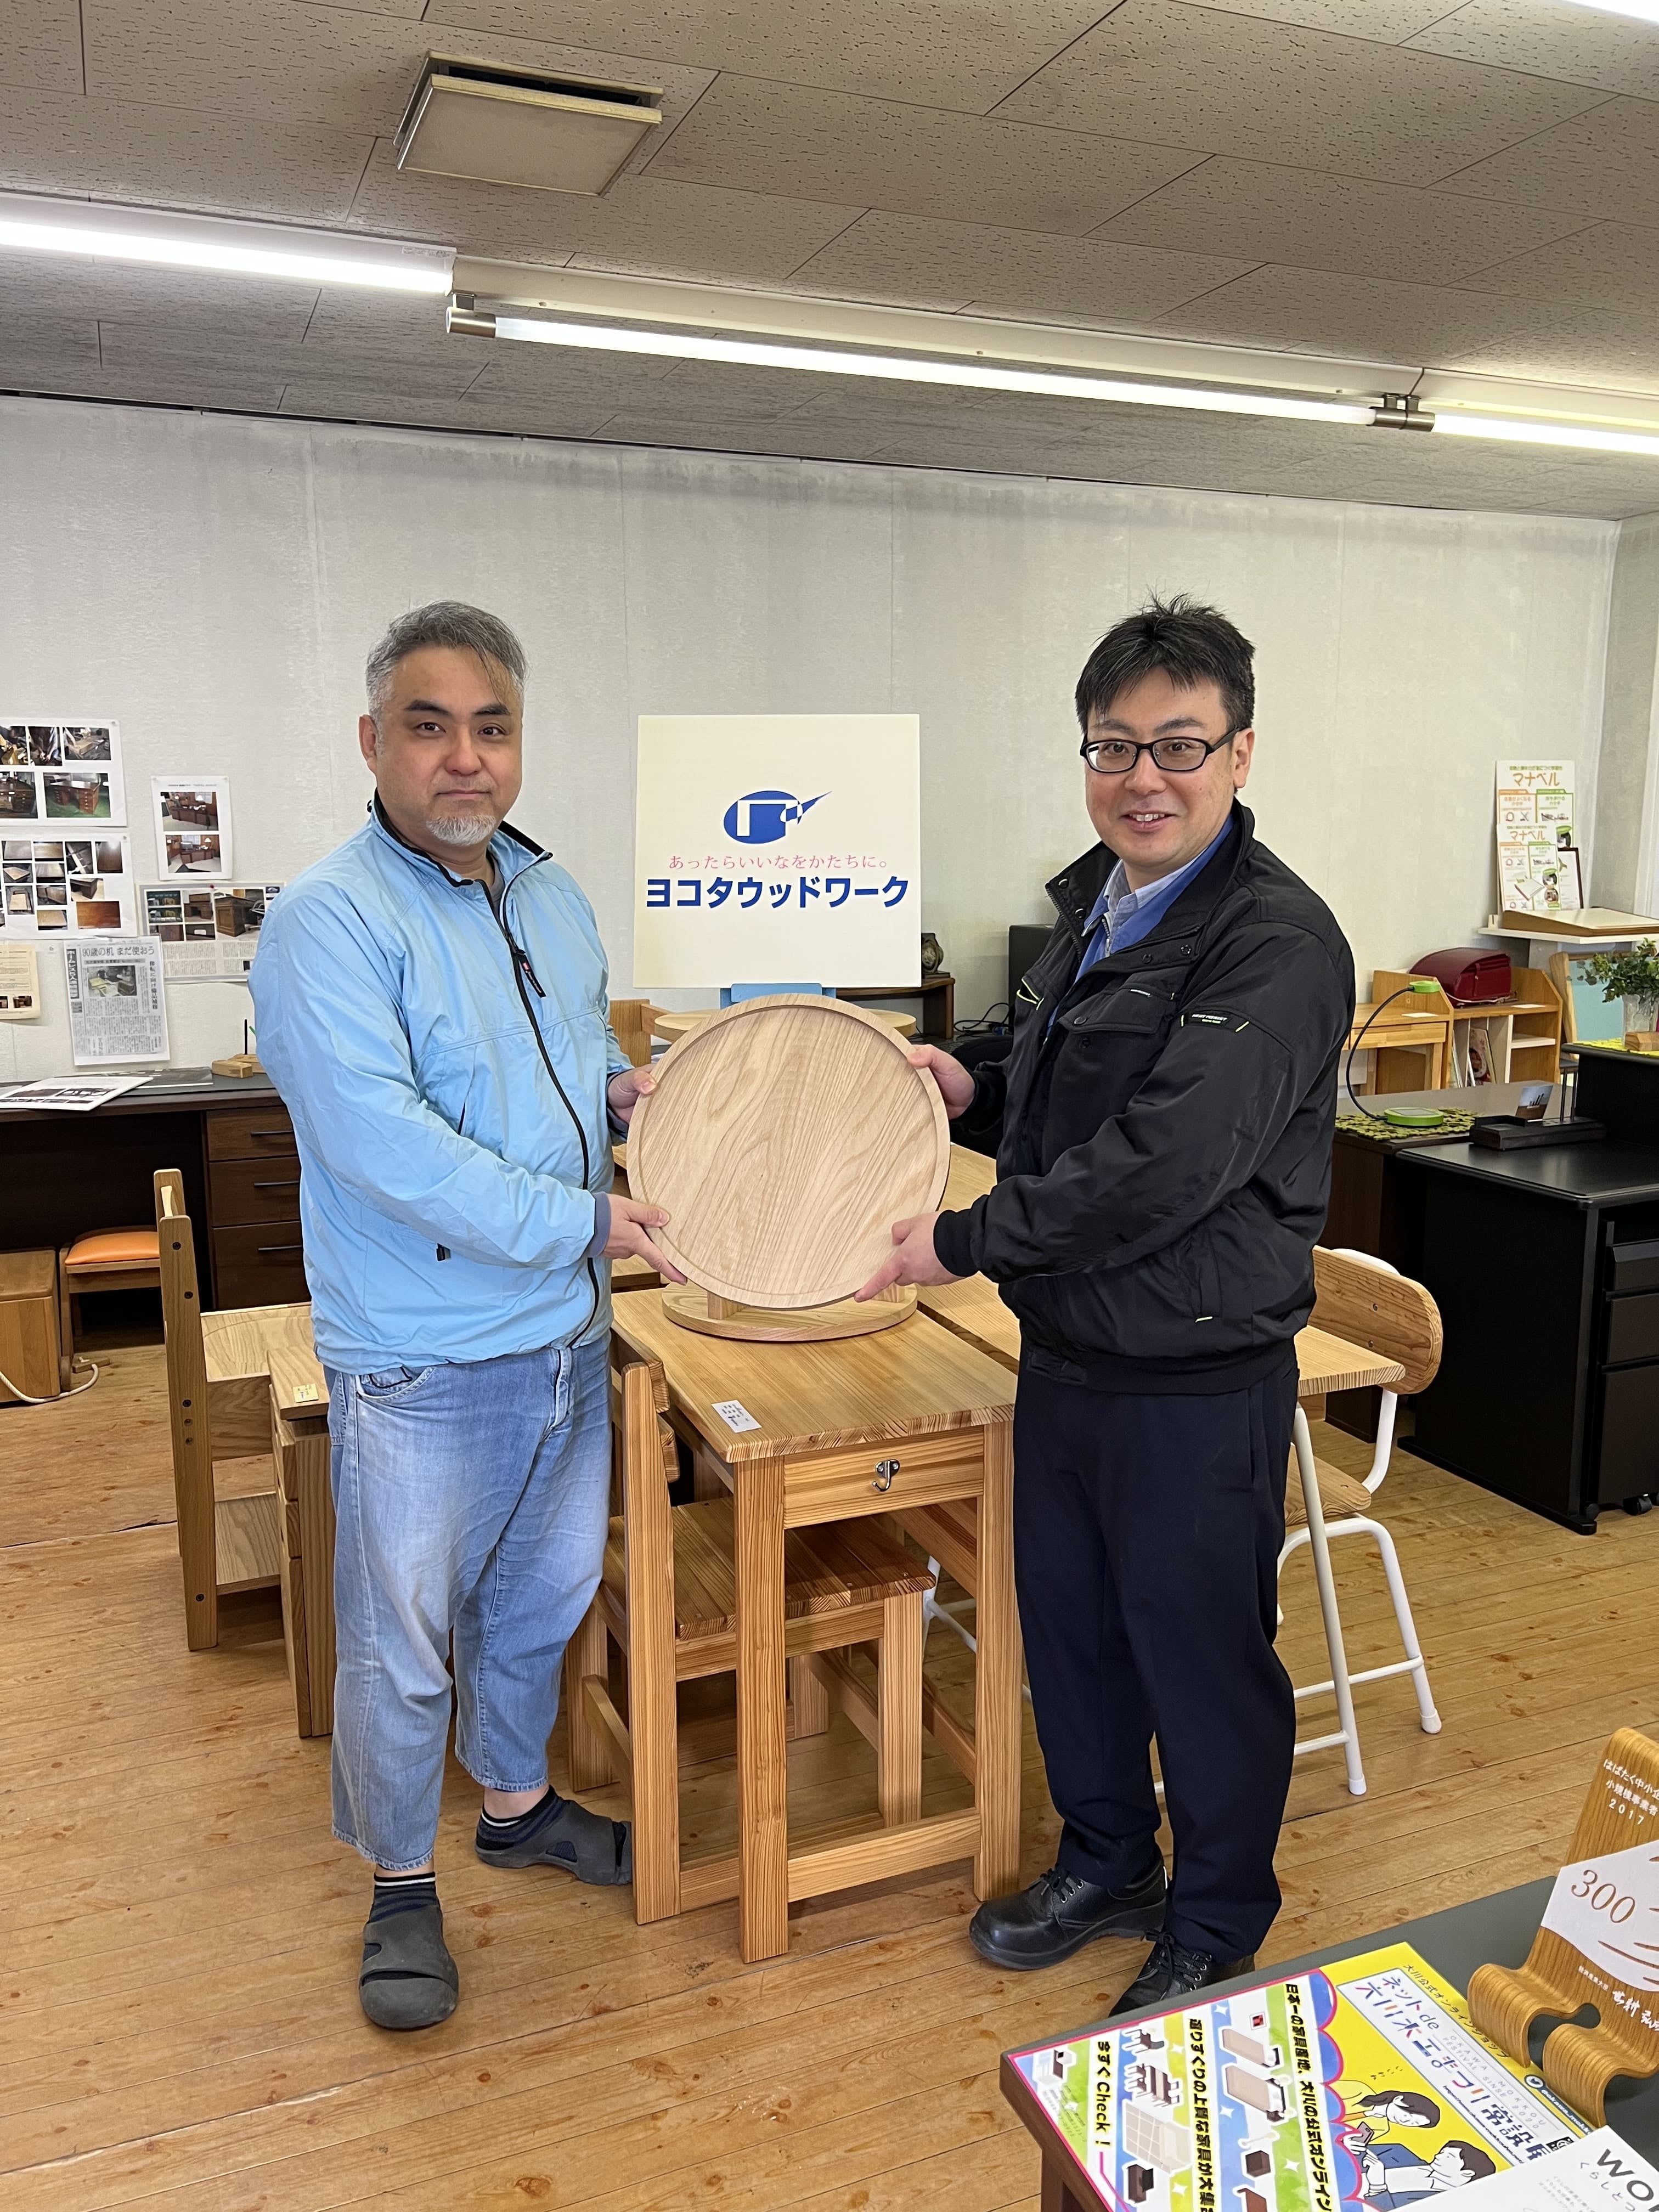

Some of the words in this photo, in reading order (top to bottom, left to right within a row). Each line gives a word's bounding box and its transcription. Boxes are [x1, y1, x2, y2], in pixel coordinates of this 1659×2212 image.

[1513, 772, 1560, 787] マナベル
[1510, 830, 1545, 841] マナベル
[668, 854, 887, 870] あったらいいなをかたちに。
[646, 876, 909, 909] ヨコタウッドワーク
[117, 946, 155, 956] まだ使おう
[1609, 1798, 1644, 1825] 2017
[1571, 1869, 1636, 1923] 300
[1442, 2037, 1476, 2071] FESTIVAL
[1483, 2076, 1508, 2097] SINSE
[1512, 2104, 1539, 2129] 2020
[1451, 2035, 1487, 2071] OKAWA
[1498, 2080, 1547, 2125] MOKKOU
[1541, 2089, 1591, 2134] @okawa_mokk
[1597, 2148, 1659, 2212] WO
